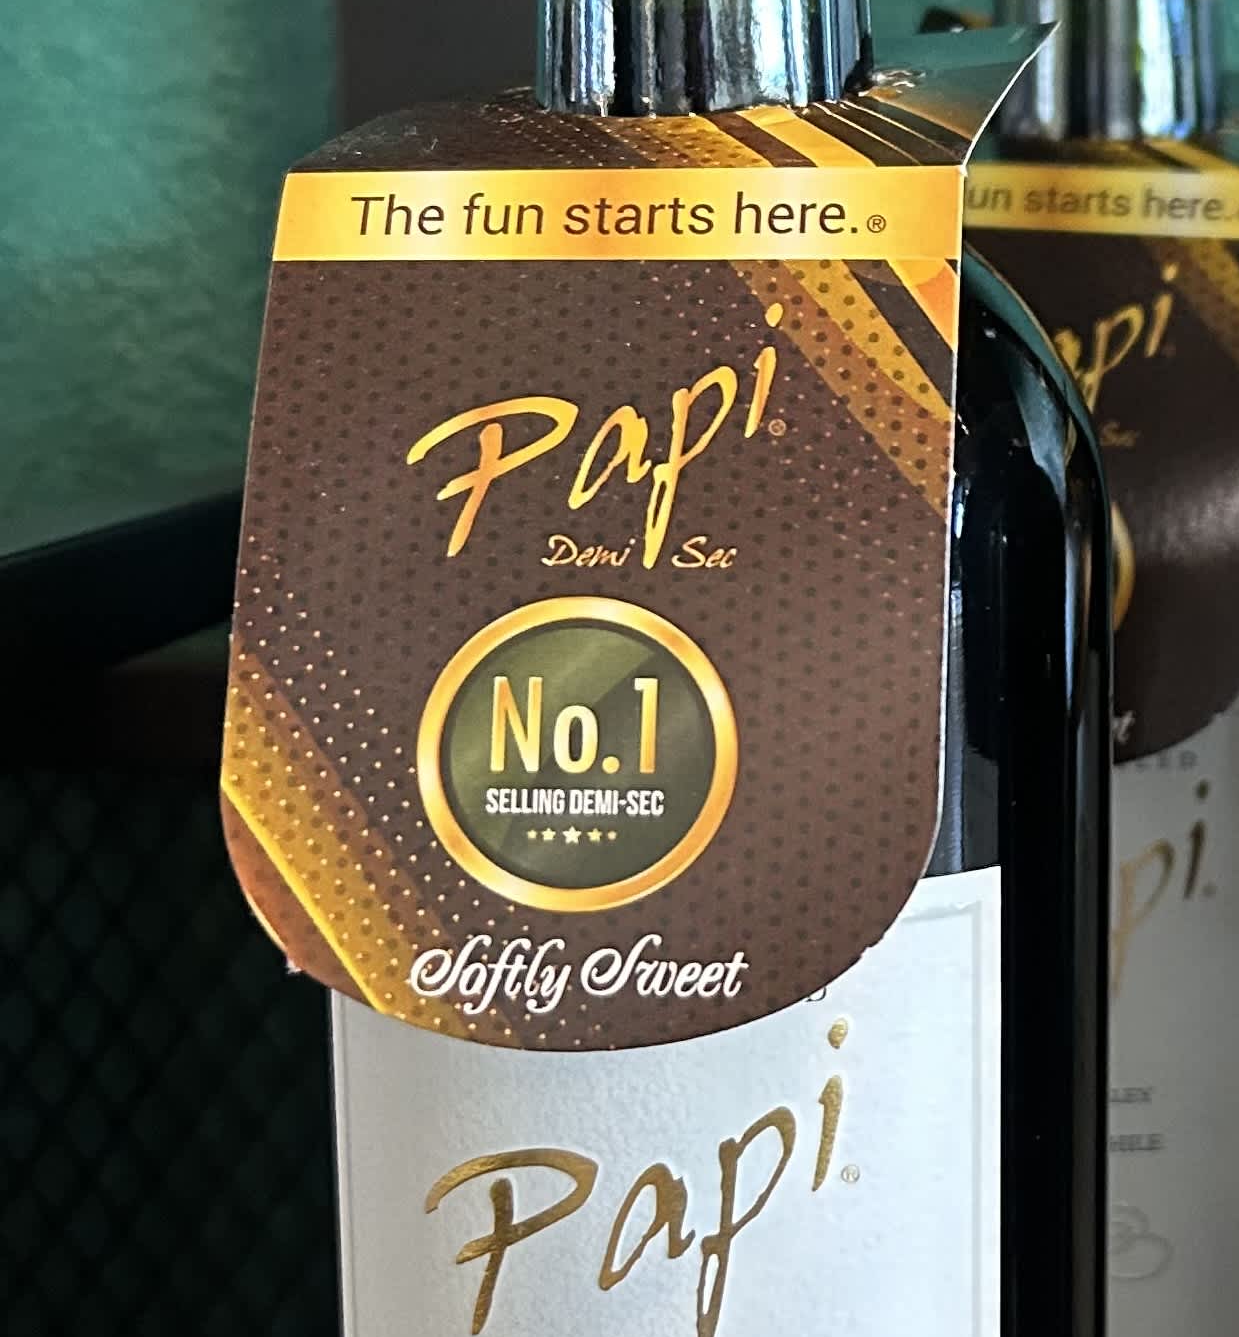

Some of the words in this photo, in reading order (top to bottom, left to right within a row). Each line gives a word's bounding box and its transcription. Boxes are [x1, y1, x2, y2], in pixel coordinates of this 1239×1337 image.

[352, 195, 444, 236] The
[463, 193, 543, 235] fun
[563, 198, 715, 235] starts
[966, 184, 1012, 210] un
[1024, 185, 1131, 217] starts
[542, 535, 632, 568] Demi
[671, 535, 738, 568] Sec
[489, 676, 660, 774] No.1
[485, 788, 565, 815] SELLING
[568, 789, 665, 817] DEMI-SEC
[409, 934, 567, 1014] Softly
[580, 934, 749, 1000] Sweet
